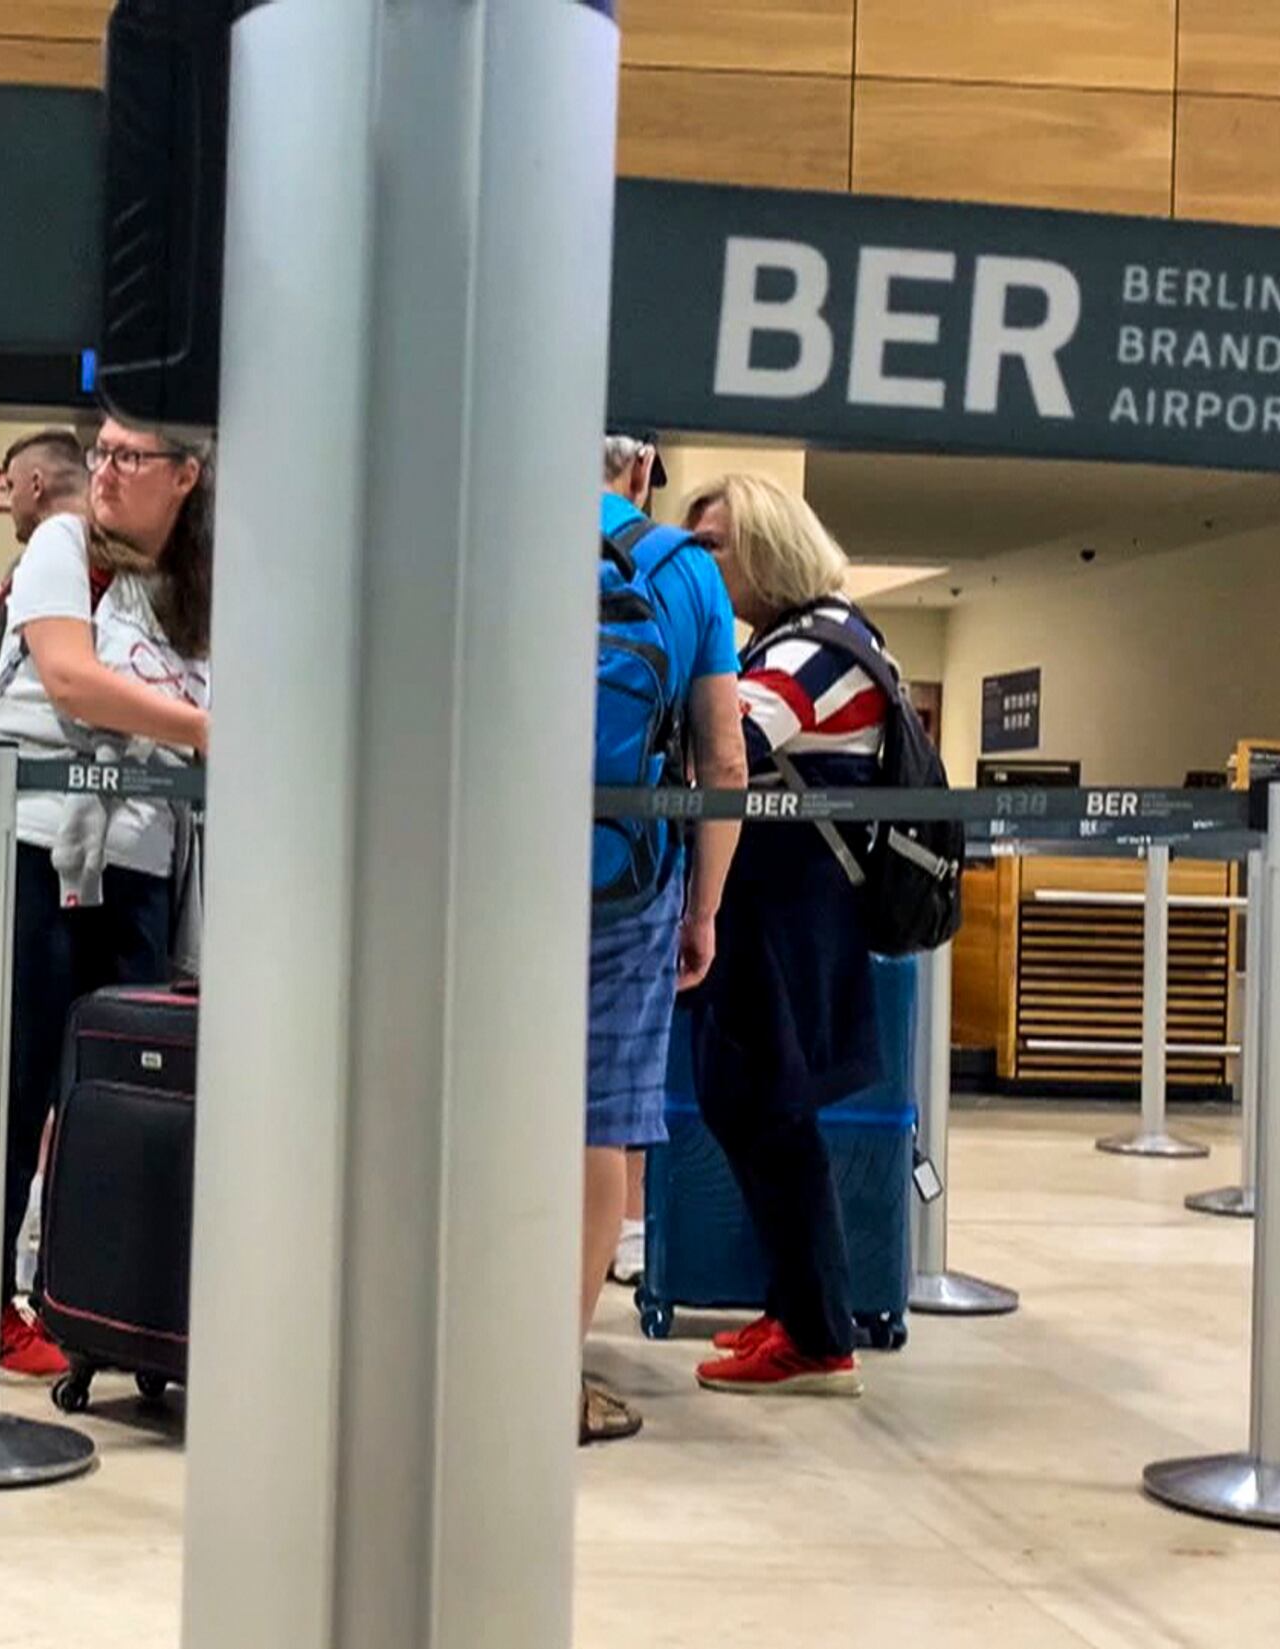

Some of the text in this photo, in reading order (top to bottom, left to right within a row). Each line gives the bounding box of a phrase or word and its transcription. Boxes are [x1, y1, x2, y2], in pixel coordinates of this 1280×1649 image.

[1123, 265, 1280, 312] BERLIN
[713, 236, 1082, 419] BER
[69, 764, 119, 791] BER
[745, 792, 798, 816] BER
[1086, 791, 1138, 817] BER
